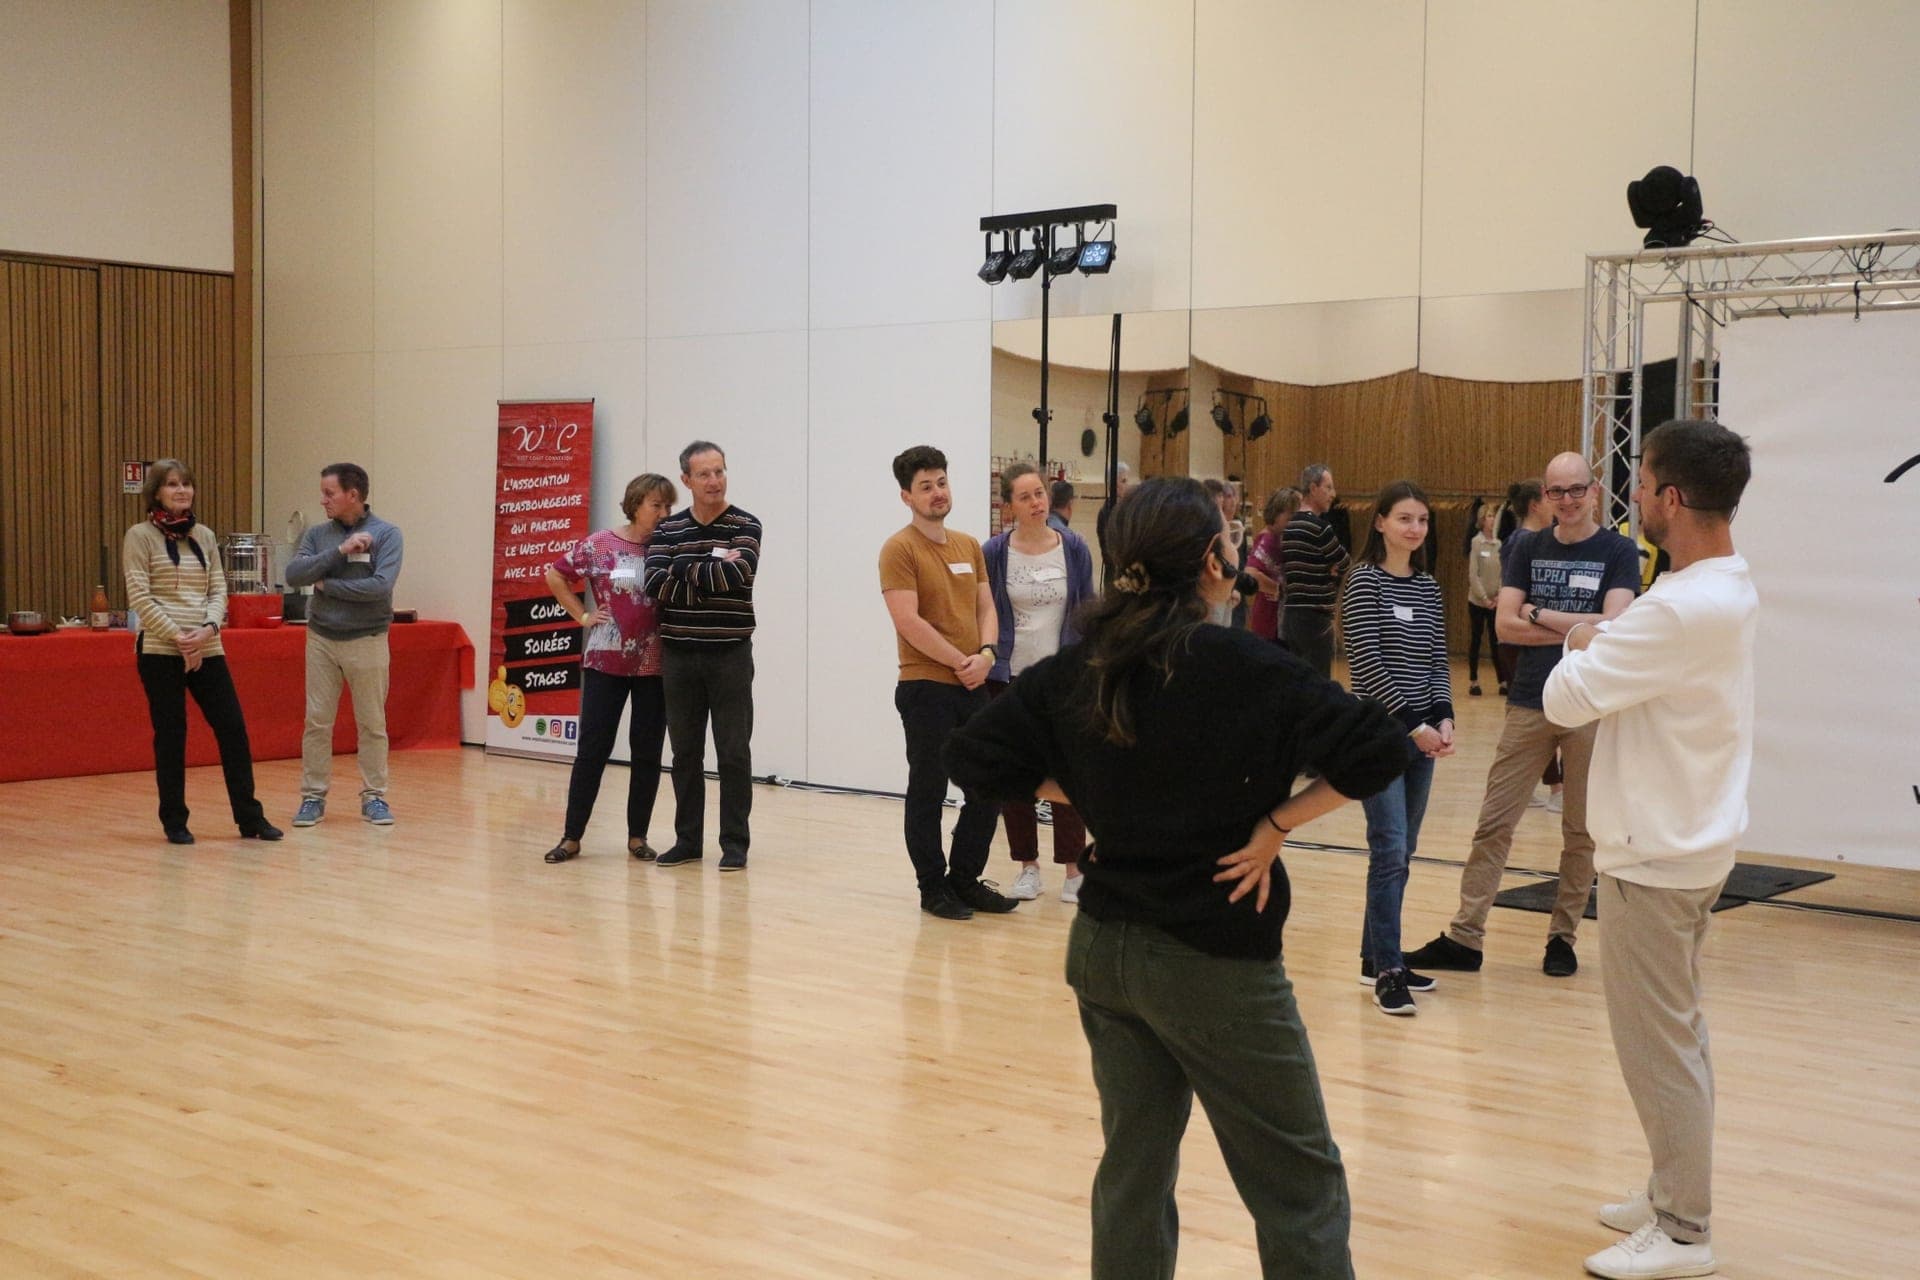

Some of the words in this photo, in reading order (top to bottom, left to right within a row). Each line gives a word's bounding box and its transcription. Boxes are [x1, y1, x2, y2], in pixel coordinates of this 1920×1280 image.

[503, 474, 570, 491] L'ASSOCIATION
[499, 495, 582, 514] STRASBOURGEOISE
[511, 522, 527, 535] QUI
[530, 518, 571, 533] PARTAGE
[505, 545, 517, 557] LE
[520, 542, 546, 555] WEST
[548, 539, 579, 553] COAST
[504, 567, 526, 579] AVEC
[529, 565, 541, 577] LE
[1530, 568, 1566, 583] ALPHA
[1530, 584, 1557, 598] SINCE
[530, 604, 567, 620] COURS
[524, 632, 572, 655] SOIRÉES
[525, 670, 569, 688] STAGES
